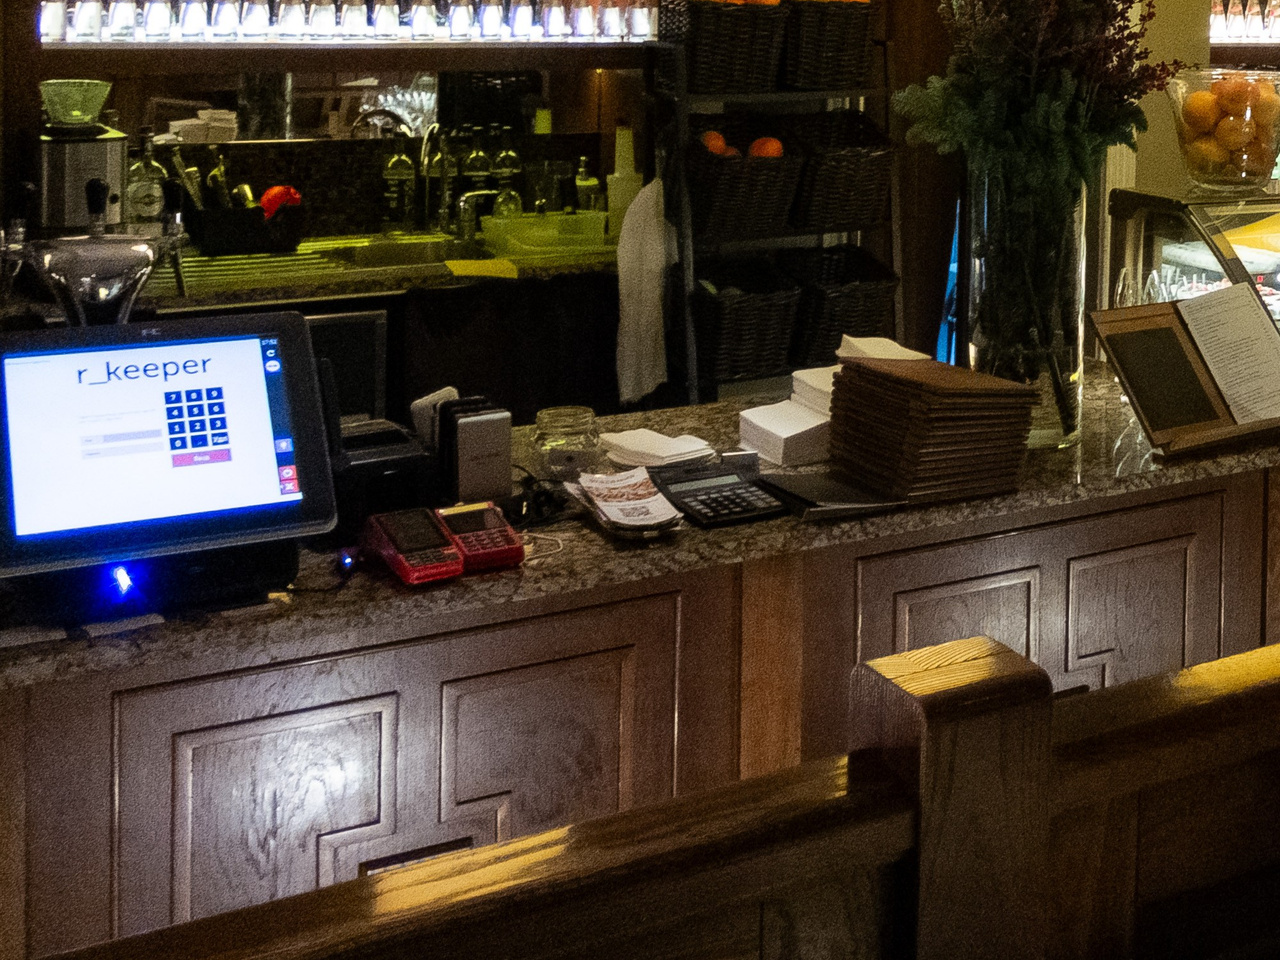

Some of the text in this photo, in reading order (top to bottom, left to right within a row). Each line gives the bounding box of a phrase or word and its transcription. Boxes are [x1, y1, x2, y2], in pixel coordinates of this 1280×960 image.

[77, 357, 212, 385] r_keeper
[169, 393, 177, 401] 7
[211, 390, 218, 398] 9
[172, 405, 220, 417] 4 5 6
[173, 420, 222, 432] 1 2 3
